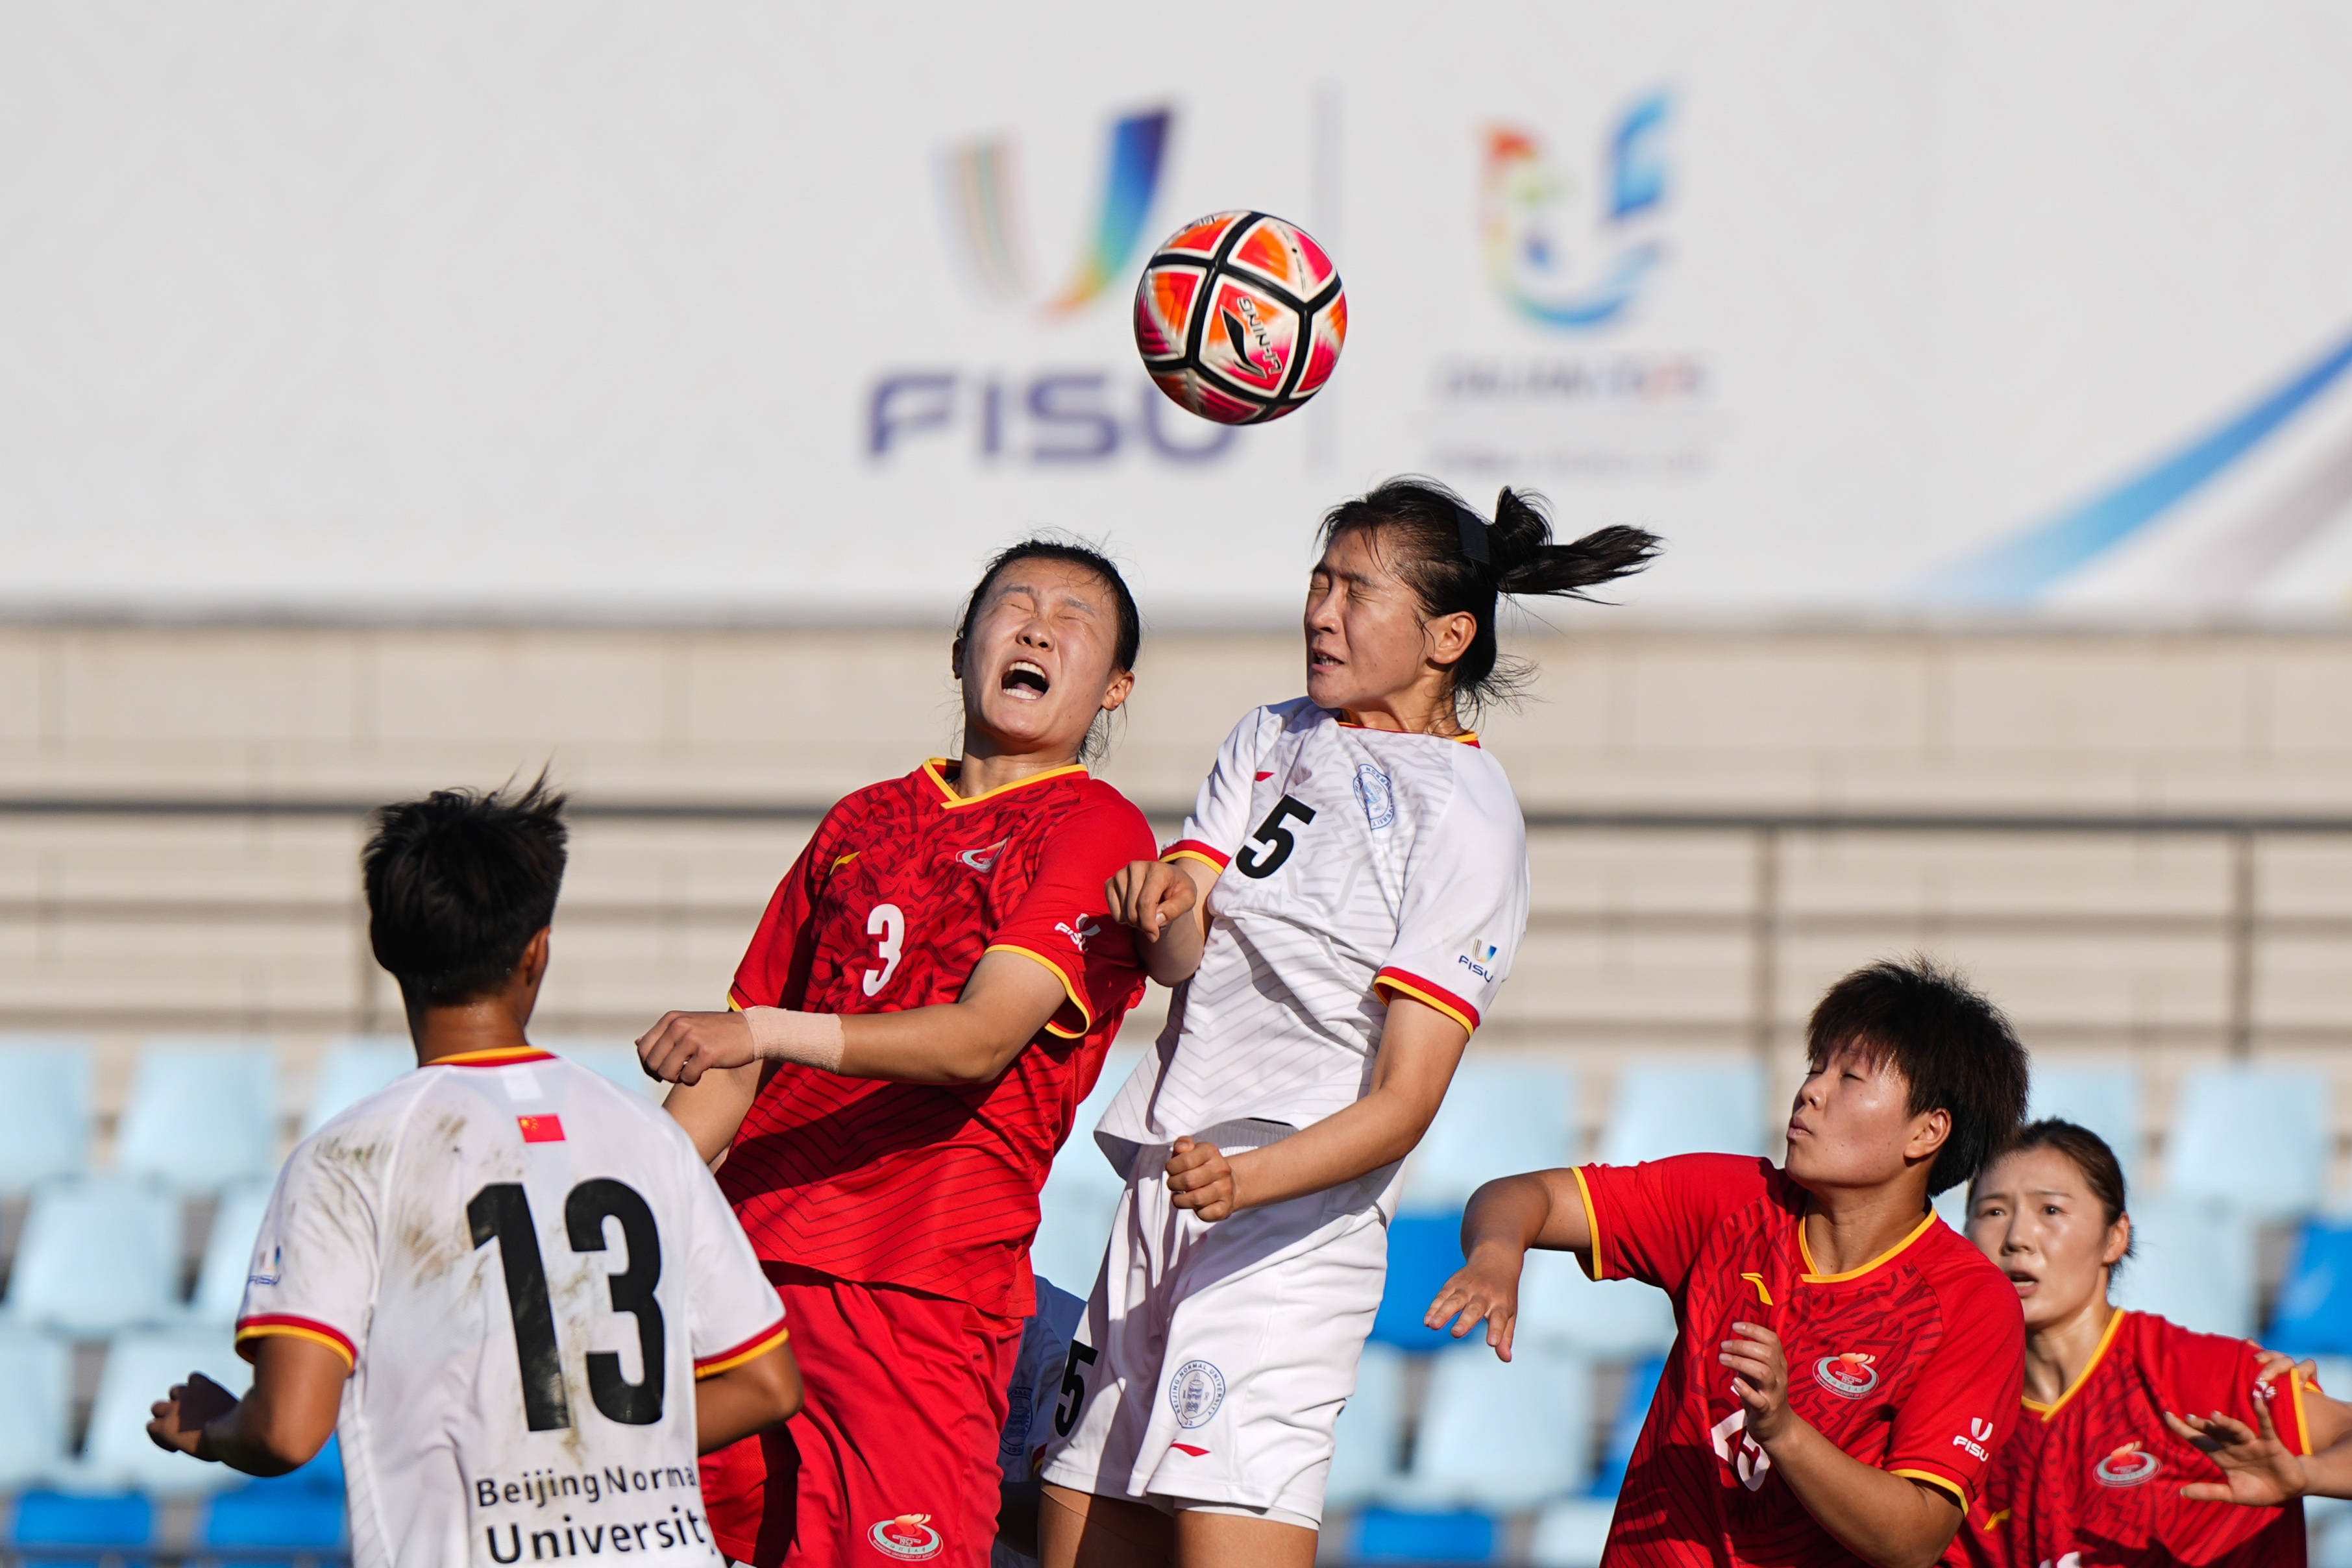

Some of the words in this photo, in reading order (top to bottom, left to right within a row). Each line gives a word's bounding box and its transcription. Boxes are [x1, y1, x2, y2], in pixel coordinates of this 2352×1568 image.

[1236, 793, 1316, 879] 5
[862, 903, 905, 996] 3
[1458, 955, 1494, 983] FISU
[467, 1177, 665, 1432] 13
[1055, 1340, 1099, 1438] 5
[1179, 1363, 1207, 1377] NORMAL
[1952, 1435, 1989, 1462] FISU
[476, 1467, 601, 1508] Beijing
[604, 1464, 698, 1494] Norma
